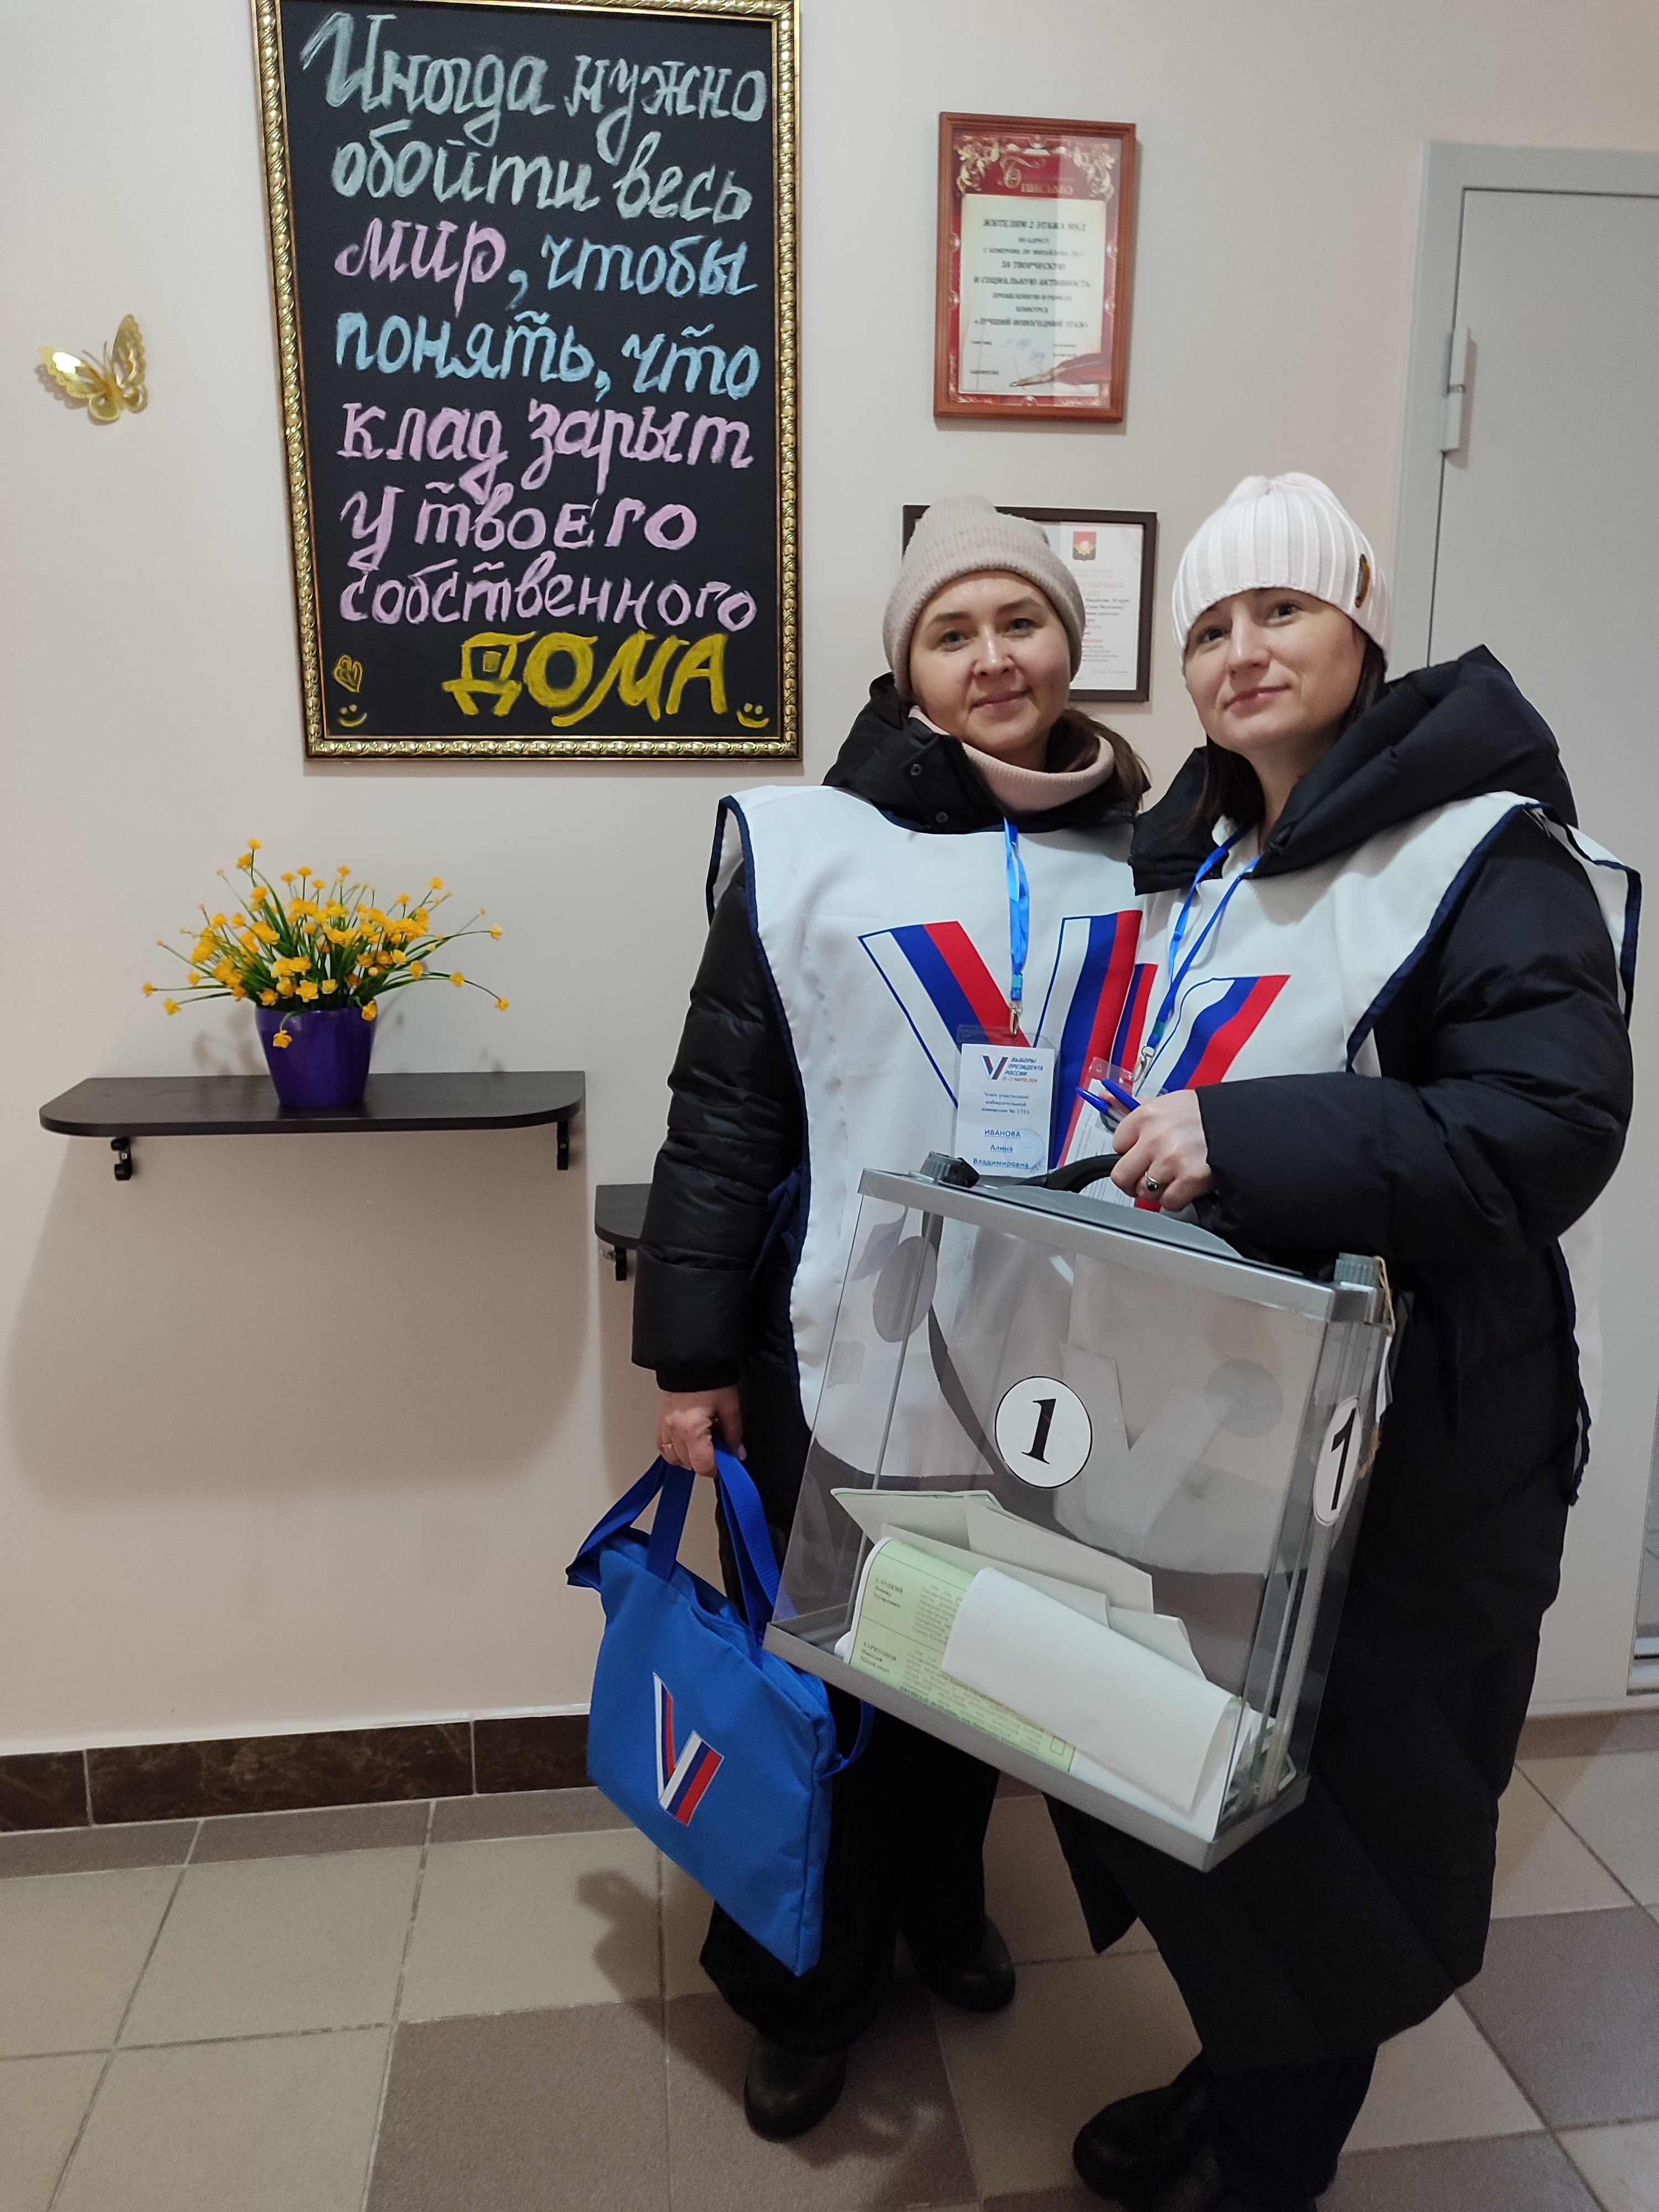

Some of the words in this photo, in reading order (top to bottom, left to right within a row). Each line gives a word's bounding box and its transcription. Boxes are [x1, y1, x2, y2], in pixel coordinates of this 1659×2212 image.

[301, 12, 555, 147] Иногда
[565, 55, 768, 165] нужно
[332, 118, 600, 211] обойти
[614, 132, 754, 224] весь
[334, 218, 530, 318] мир,
[540, 234, 758, 299] чтобы
[335, 310, 611, 402] понять,
[622, 324, 760, 400] что
[337, 403, 509, 504] клад
[521, 398, 754, 494] зарыт
[340, 486, 405, 571] у
[414, 481, 698, 551] твоего
[338, 551, 757, 632] собственного
[442, 630, 729, 727] ДОМА
[973, 1157, 1030, 1168] Владимировна
[984, 1129, 1021, 1138] ИВАНОВА
[990, 1144, 1014, 1152] Алина
[1020, 1397, 1057, 1465] 1
[1331, 1407, 1358, 1512] 1
